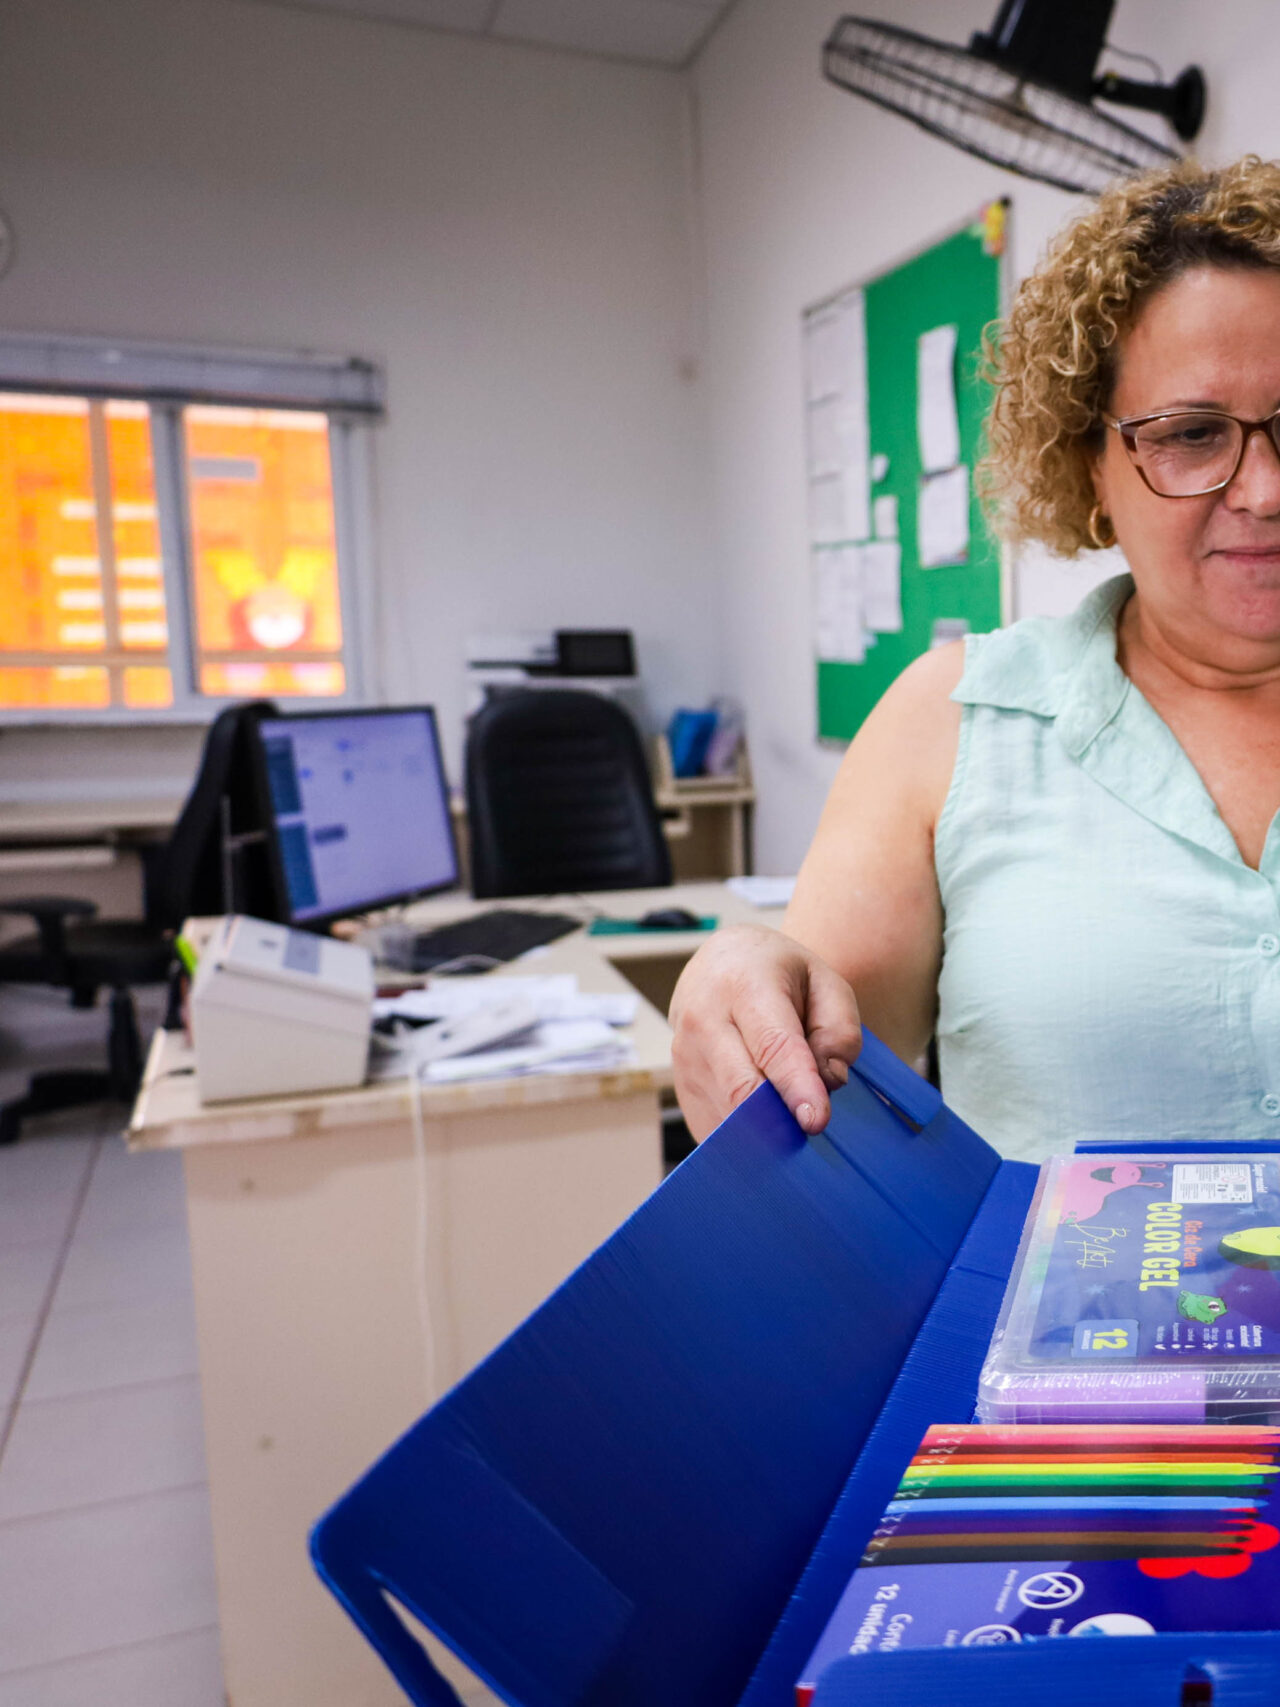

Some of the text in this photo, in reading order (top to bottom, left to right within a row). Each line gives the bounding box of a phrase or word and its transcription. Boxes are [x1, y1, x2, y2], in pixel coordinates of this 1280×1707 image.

[1139, 1202, 1183, 1291] COLOR GEL
[1183, 1220, 1203, 1267] Giz de Cera
[1092, 1328, 1128, 1350] 12
[875, 1583, 900, 1601] 12
